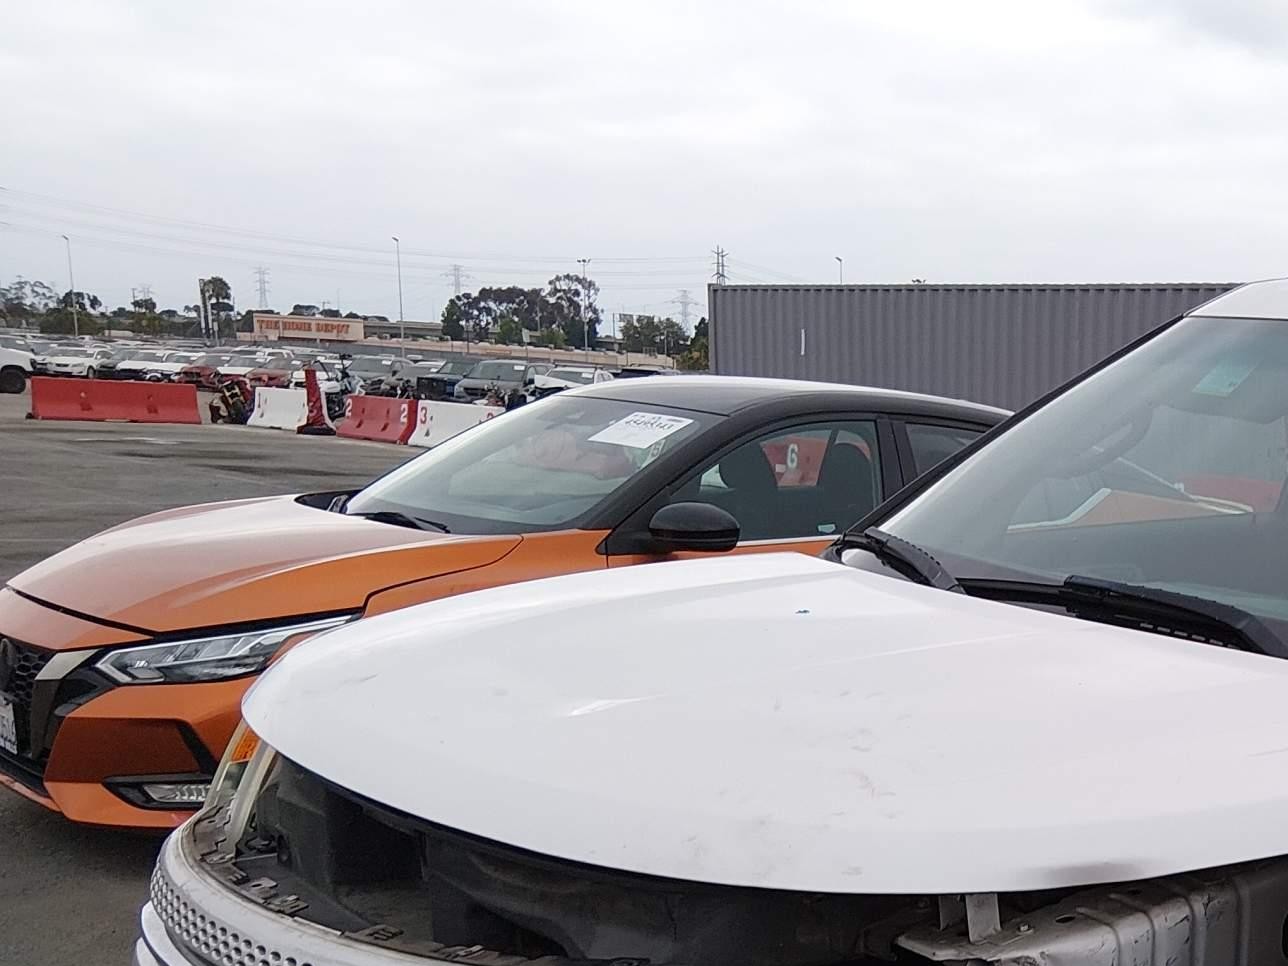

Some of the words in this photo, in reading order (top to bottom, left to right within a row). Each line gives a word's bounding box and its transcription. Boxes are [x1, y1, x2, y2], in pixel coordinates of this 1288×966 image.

[257, 319, 280, 330] THE
[282, 321, 313, 332] HOME
[315, 323, 350, 334] DEPOT
[345, 398, 353, 417] 2
[400, 402, 409, 423] 2
[420, 406, 428, 424] 3
[786, 442, 799, 469] 6
